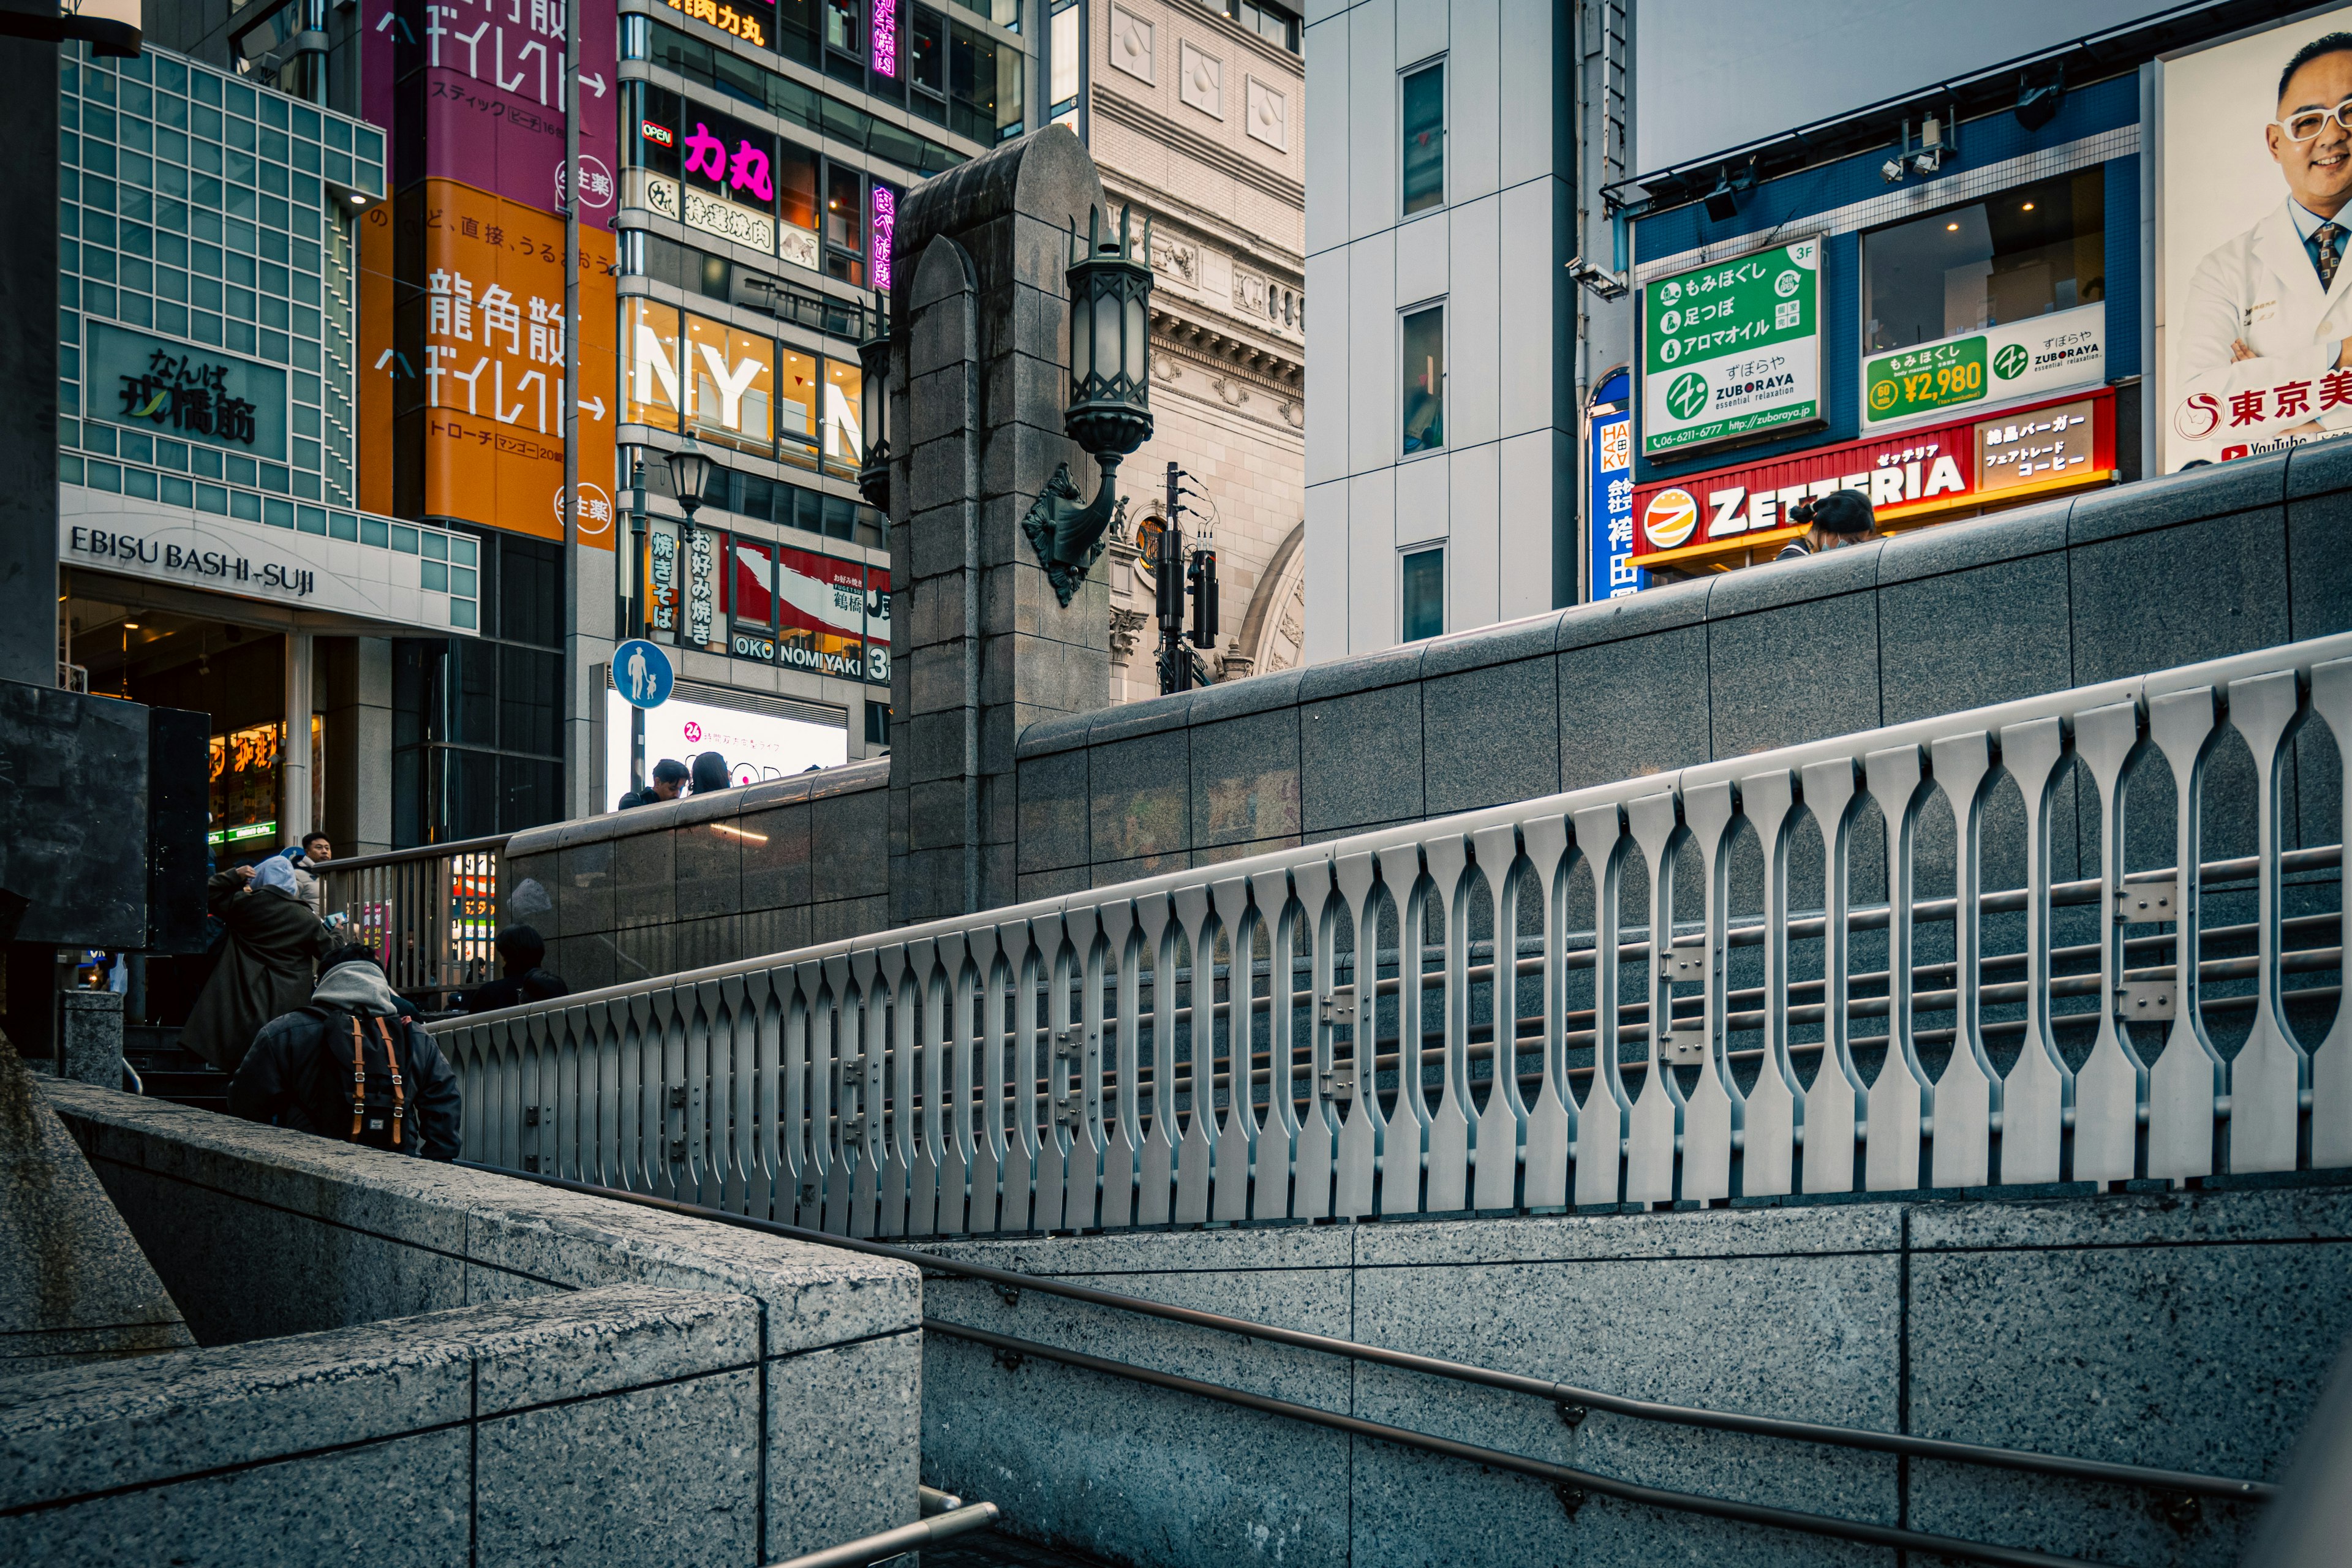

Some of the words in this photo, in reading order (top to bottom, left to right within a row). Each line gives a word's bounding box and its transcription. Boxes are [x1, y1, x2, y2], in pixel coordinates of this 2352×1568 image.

[432, 81, 505, 116] スティック
[643, 124, 671, 143] OPEN
[685, 123, 773, 202] 力丸
[685, 194, 771, 248] 特選焼肉
[1796, 246, 1813, 260] 3F
[1686, 263, 1766, 296] もみほぐし
[1780, 283, 1795, 292] OPEN
[1781, 276, 1793, 285] 24H
[430, 268, 582, 369] 龍角散
[1684, 296, 1735, 327] 足つぼ
[1684, 319, 1770, 356] アロマオイル
[2043, 331, 2092, 350] ずぼらや
[1891, 345, 1960, 371] もみほぐし
[2034, 360, 2062, 372] essential
[2067, 353, 2099, 365] relaxation
[2035, 344, 2099, 364] ZUBORAYA
[150, 348, 228, 391] なんば
[1725, 356, 1785, 380] ずぼらや
[1909, 364, 1932, 374] massage
[1716, 373, 1794, 400] ZUBORAYA
[1877, 385, 1890, 398] 60
[1904, 362, 1981, 403] ¥2,980
[119, 374, 256, 445] 戎橋筋
[1716, 394, 1750, 410] essential
[1755, 386, 1794, 401] relaxation
[2228, 369, 2352, 428] 東京美
[431, 420, 492, 445] トローチ
[499, 437, 536, 453] マンゴー
[1660, 424, 1722, 447] 06-6211-6777
[1728, 405, 1811, 431] http://zuboraya.jp
[1986, 415, 2085, 445] 絶品バーガー
[1877, 444, 1939, 467] ゼッテリア
[1986, 441, 2065, 467] フェアトレード
[2018, 455, 2084, 477] コーヒー
[72, 526, 158, 564] EBISU
[165, 543, 314, 597] BASHI-SUJI
[652, 532, 673, 630] 焼きそば
[691, 529, 712, 646] お好み焼き
[834, 573, 862, 587] お好み焼き
[834, 584, 861, 595] FUGETSU
[834, 592, 862, 614] 鶴橋
[736, 637, 774, 660] OKO
[780, 646, 861, 676] NOMIYAKI
[686, 723, 700, 737] 24
